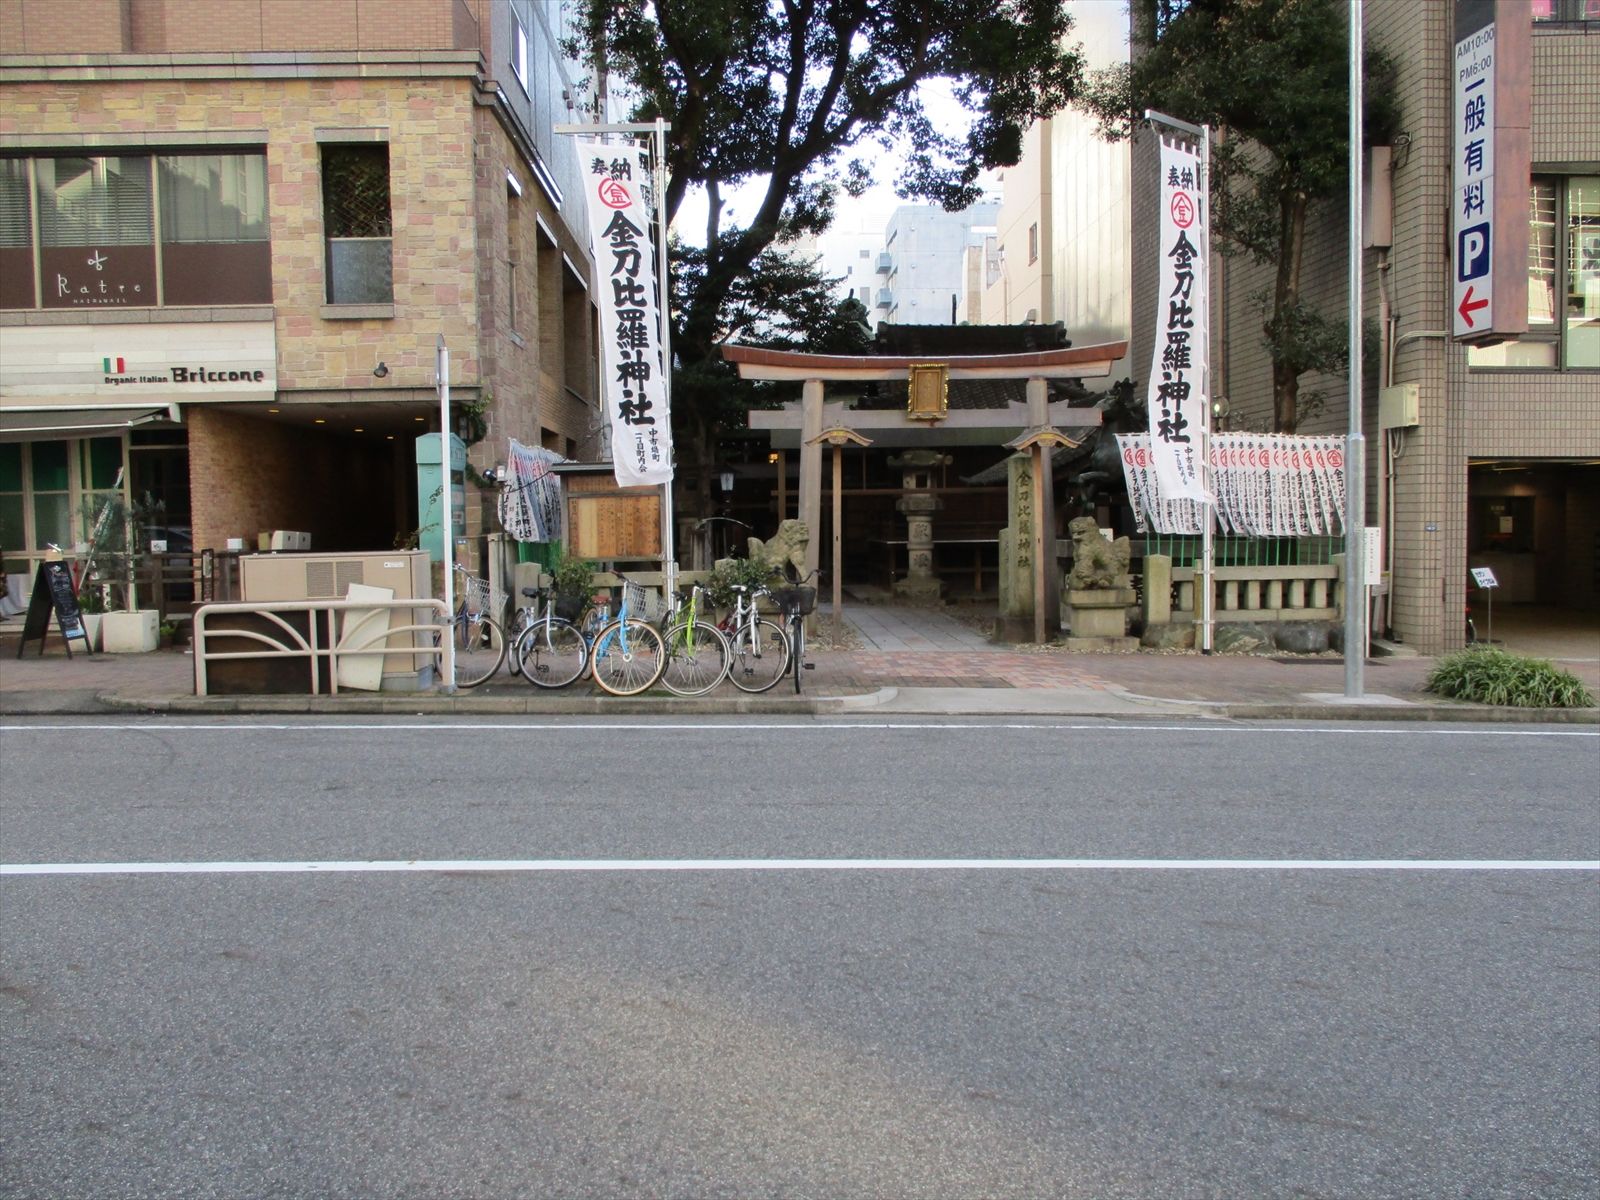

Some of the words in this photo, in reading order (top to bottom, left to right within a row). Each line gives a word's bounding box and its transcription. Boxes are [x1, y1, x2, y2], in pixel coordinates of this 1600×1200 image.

[1457, 26, 1495, 59] AM10:00
[1460, 55, 1492, 82] PM6:00
[1464, 78, 1485, 220] 一般有料
[591, 157, 632, 182] 奉納
[1167, 166, 1194, 190] 奉納
[601, 210, 656, 426] 金刀比羅神社
[1156, 230, 1198, 444] 金刀比羅神社
[104, 376, 137, 385] Organic
[139, 375, 168, 383] Italian
[171, 367, 265, 382] Briccone
[1016, 471, 1032, 568] 金刀比羅神社
